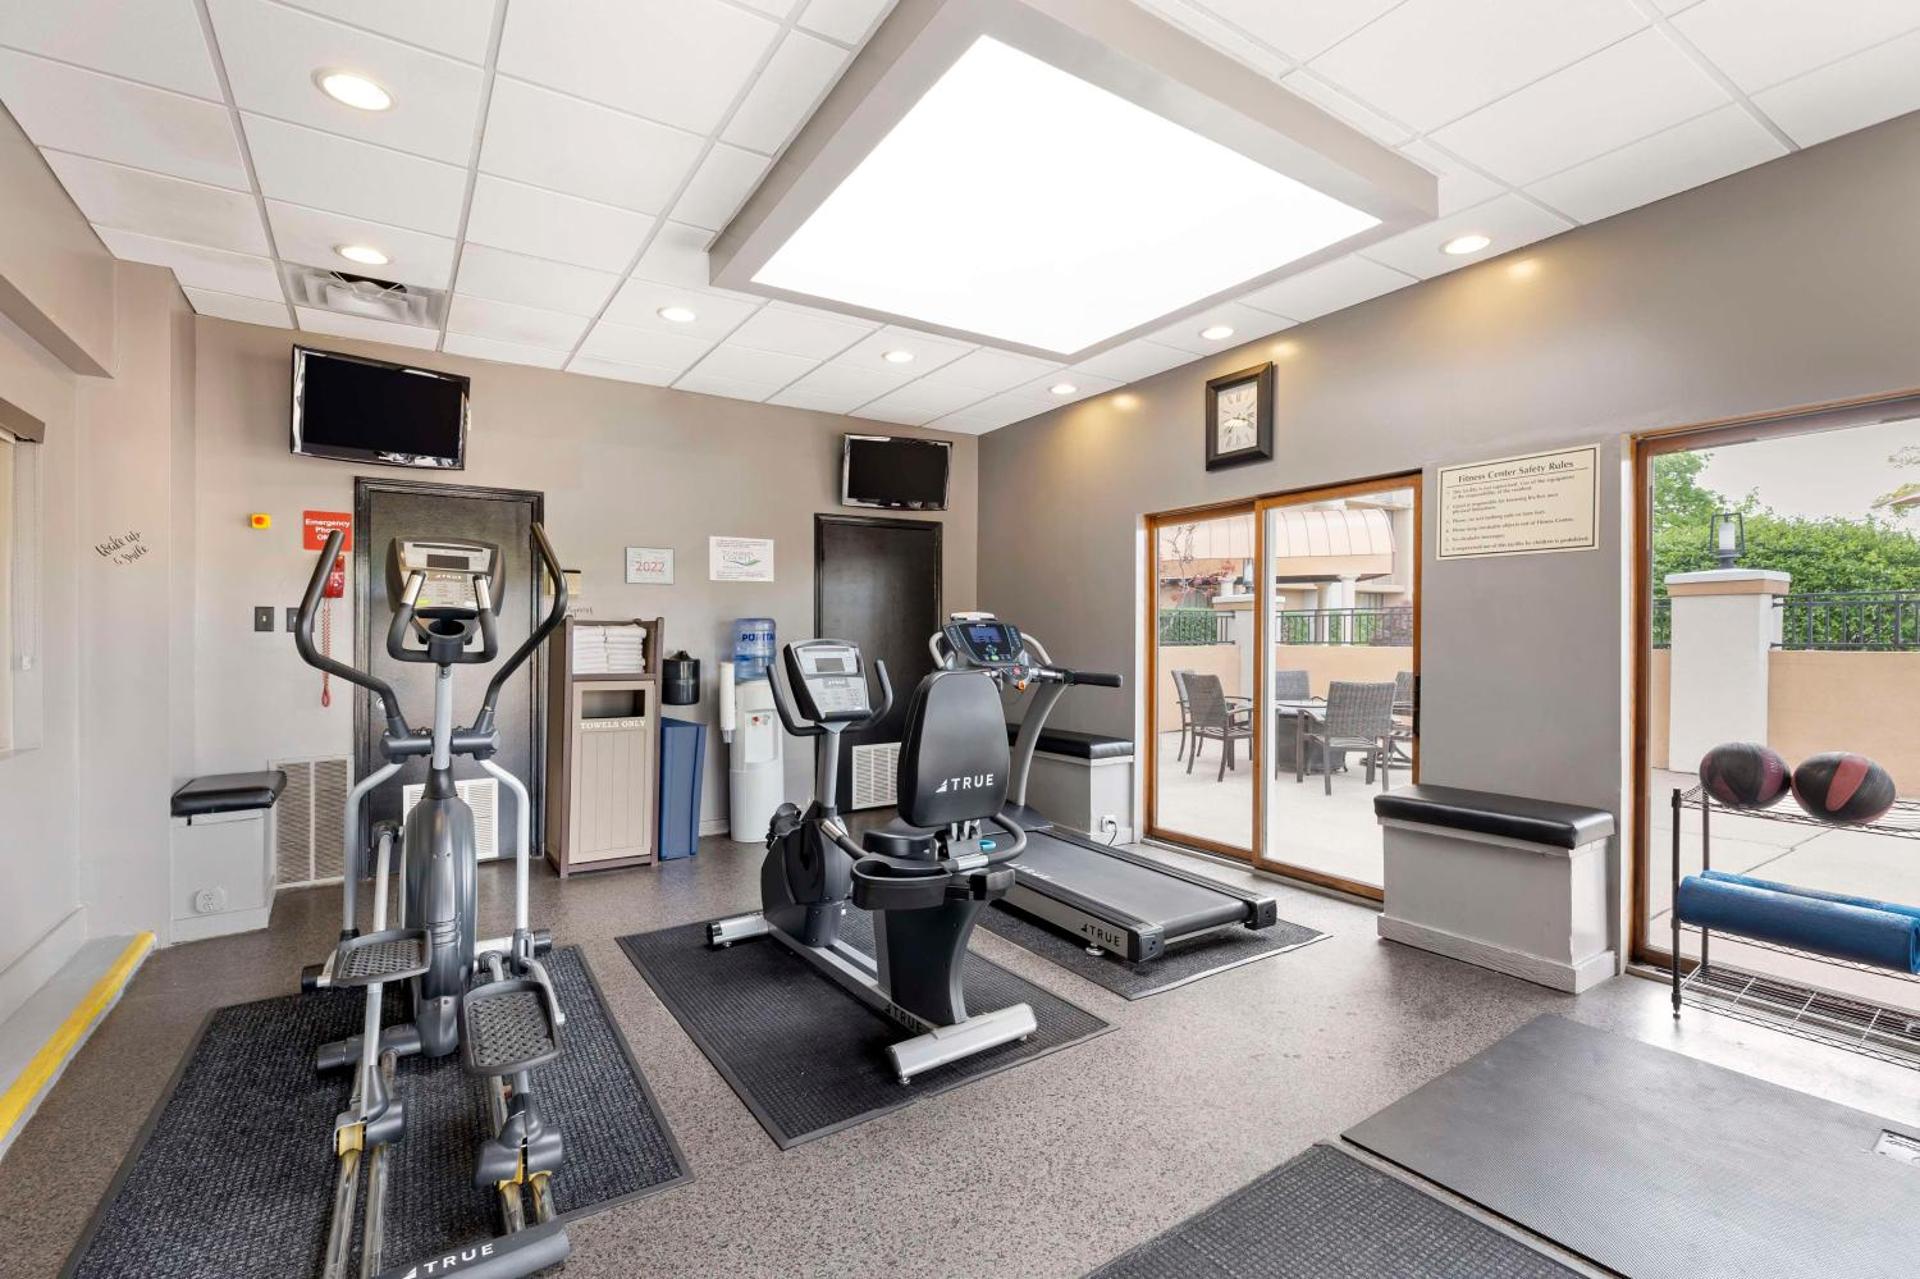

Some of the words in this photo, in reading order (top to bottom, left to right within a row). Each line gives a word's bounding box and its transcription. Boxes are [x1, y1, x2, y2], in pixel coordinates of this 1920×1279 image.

[1457, 474, 1485, 483] Fitness
[1487, 469, 1516, 479] Center
[1518, 464, 1546, 475] Safety
[1548, 460, 1574, 471] Rules
[305, 518, 350, 529] Emergency
[124, 530, 142, 543] up
[635, 561, 665, 573] 2022
[580, 720, 620, 730] TOWELS
[620, 719, 646, 729] ONLY
[950, 773, 995, 791] TRUE
[1090, 925, 1121, 948] TRUE
[423, 1243, 495, 1274] TRUE
